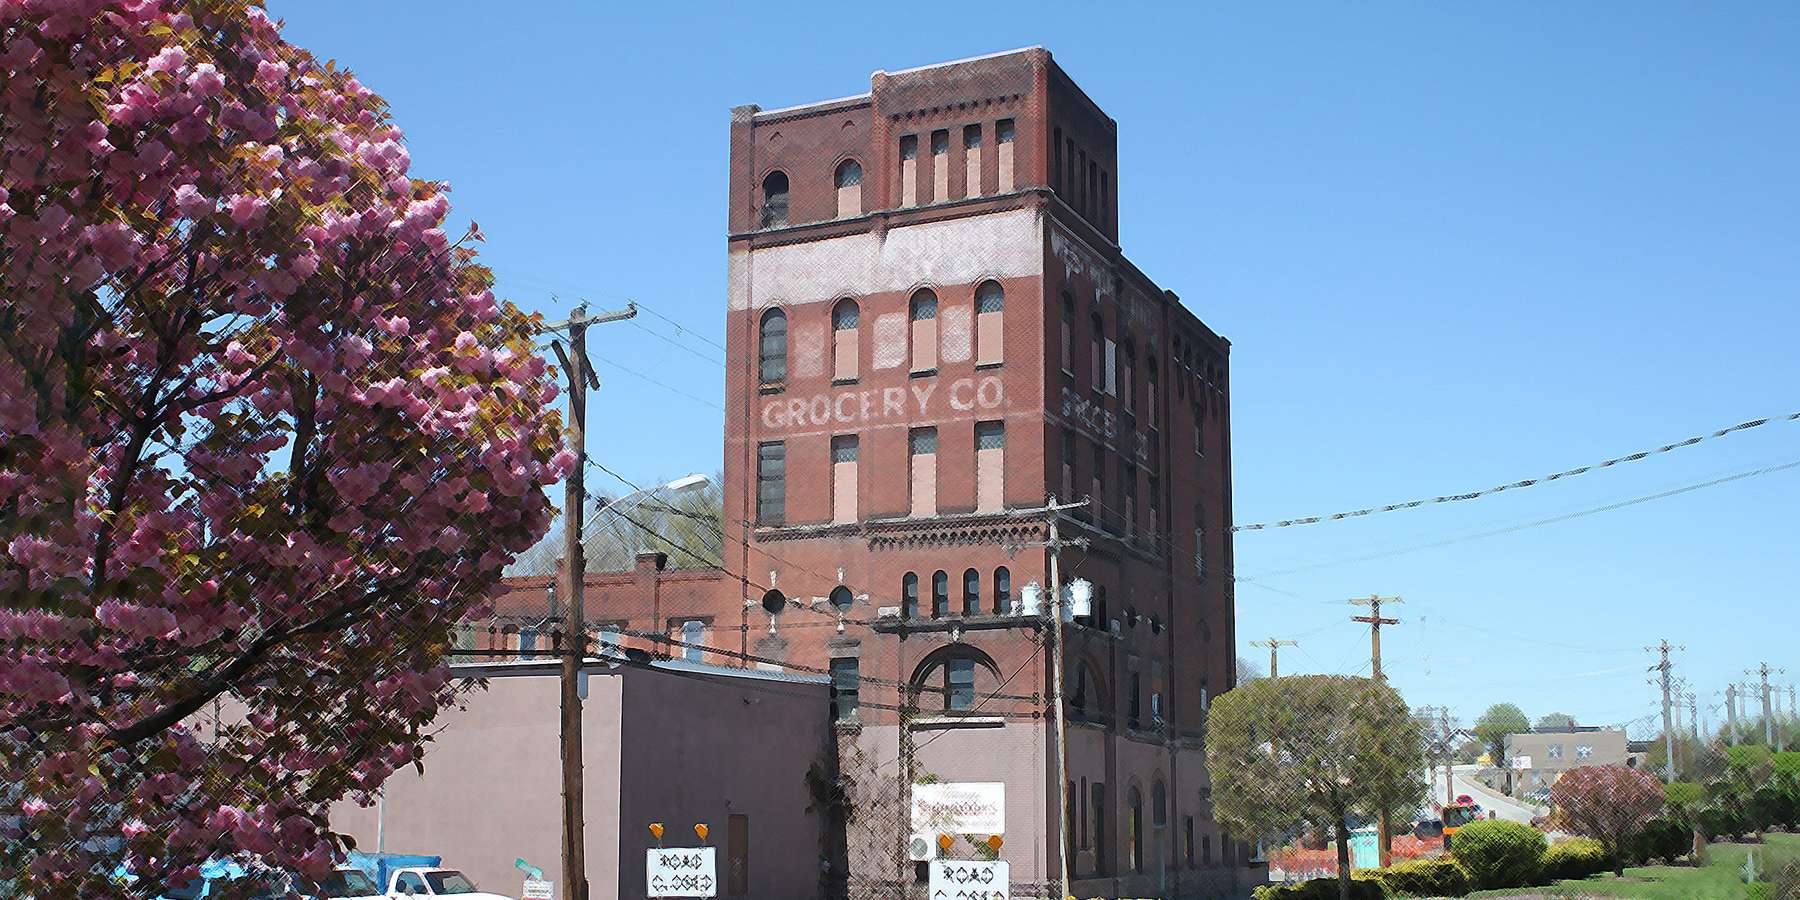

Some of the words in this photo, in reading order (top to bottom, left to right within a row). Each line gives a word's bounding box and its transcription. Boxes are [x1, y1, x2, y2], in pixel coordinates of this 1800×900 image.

[761, 383, 937, 430] GROCERY
[660, 854, 703, 870] ROAD
[943, 866, 994, 884] ROAD
[934, 889, 1005, 900] COSED
